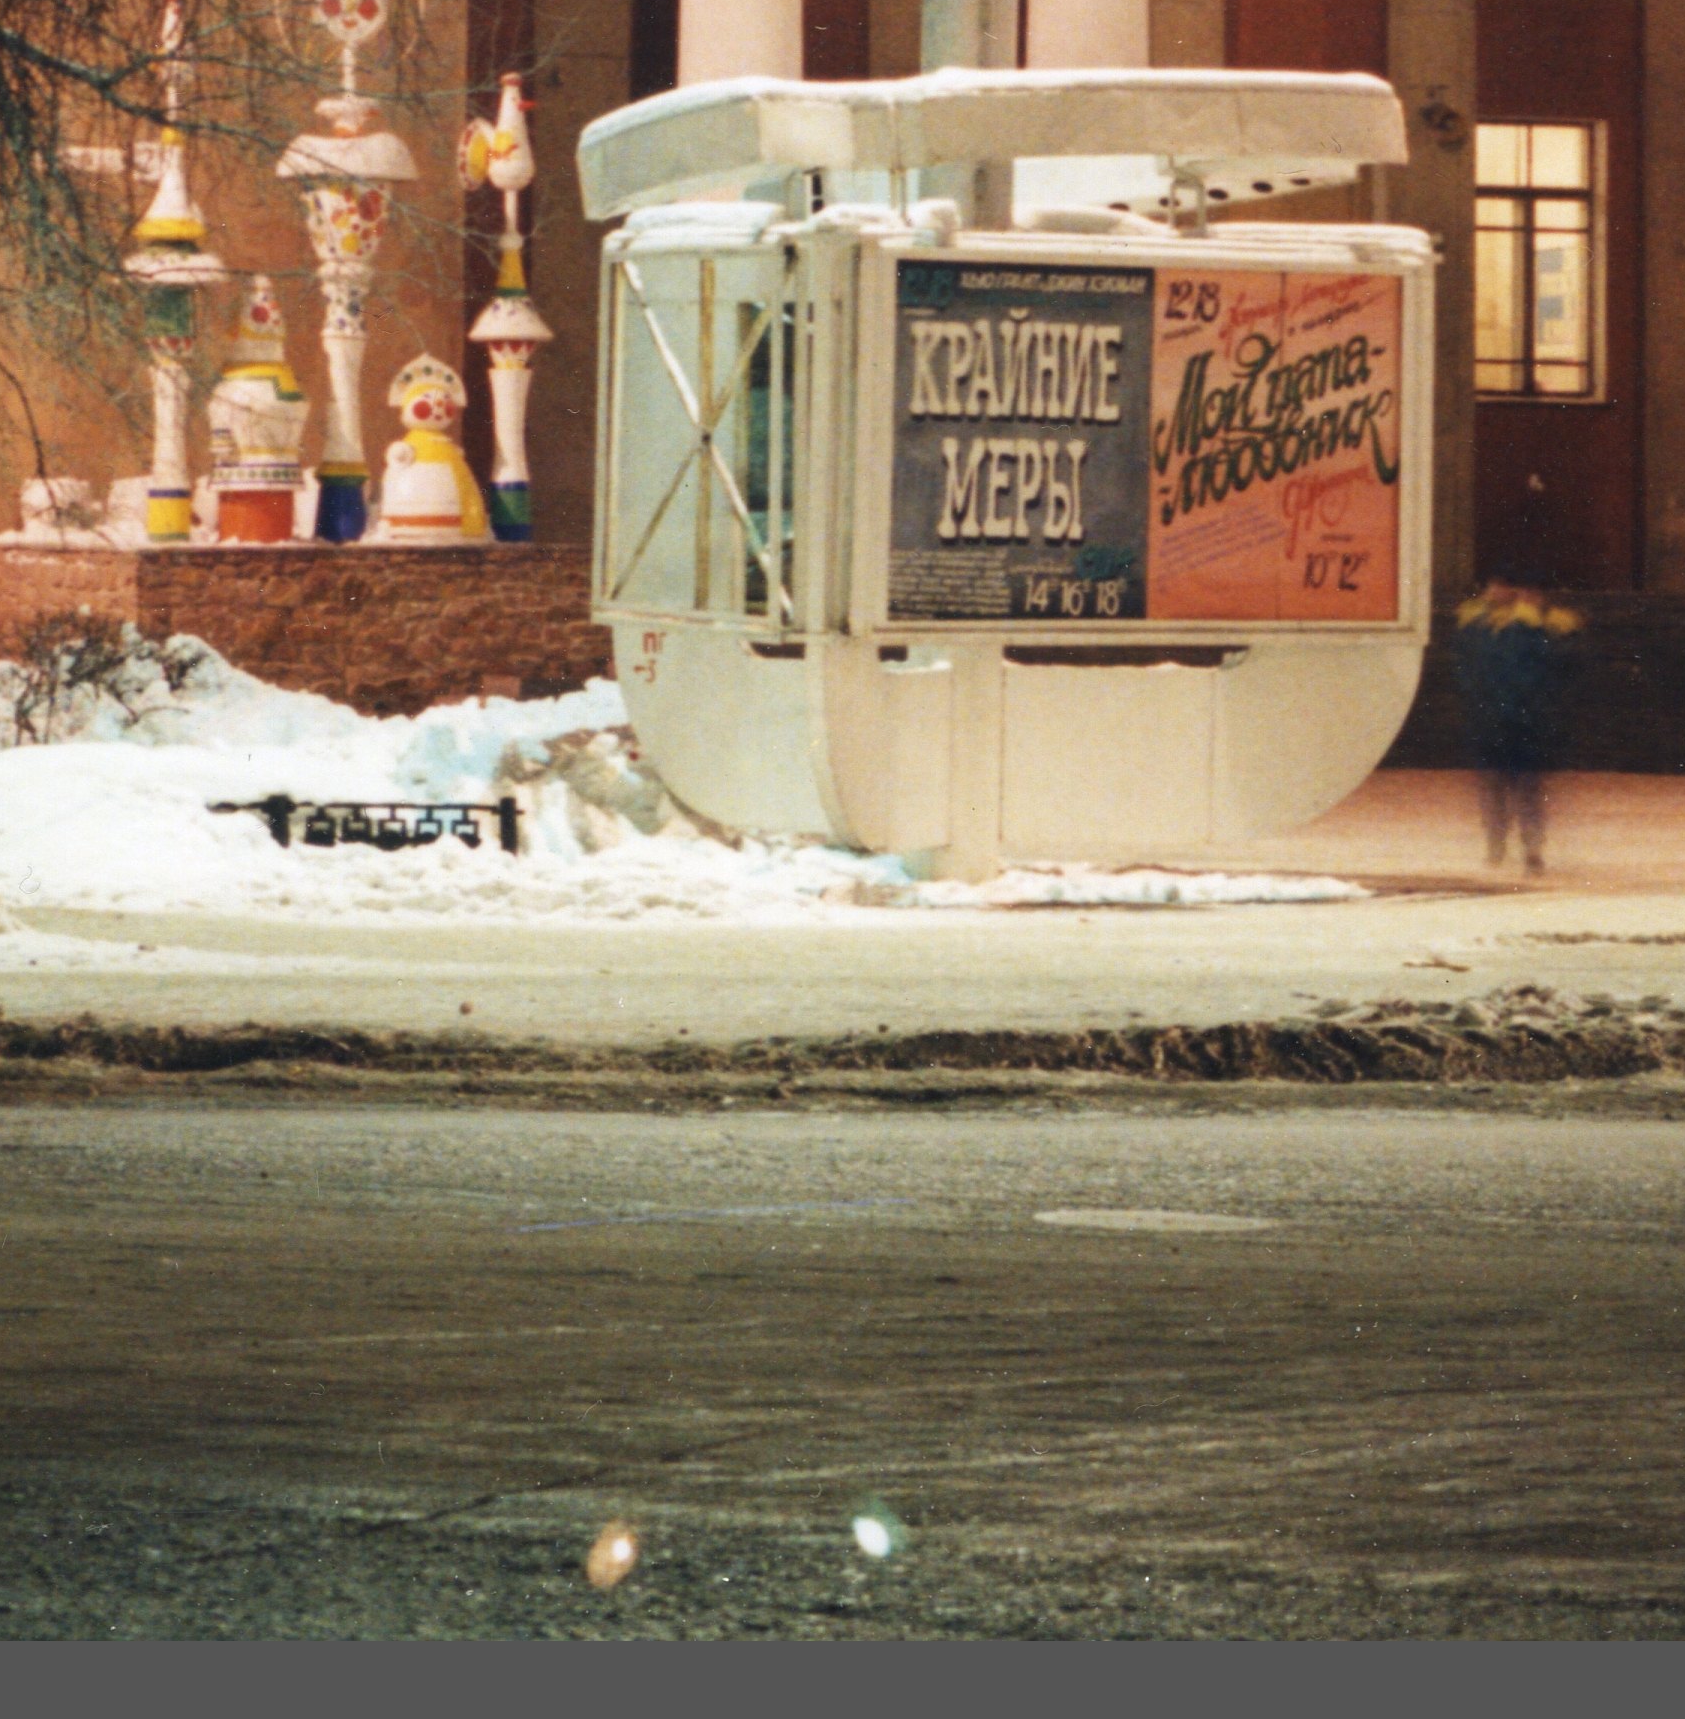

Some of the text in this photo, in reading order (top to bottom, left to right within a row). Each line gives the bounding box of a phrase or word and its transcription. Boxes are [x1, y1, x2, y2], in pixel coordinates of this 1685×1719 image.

[909, 306, 1122, 422] КРАЙНИЕ
[1153, 333, 1282, 475] Мой
[937, 437, 1088, 543] МЕРЫ
